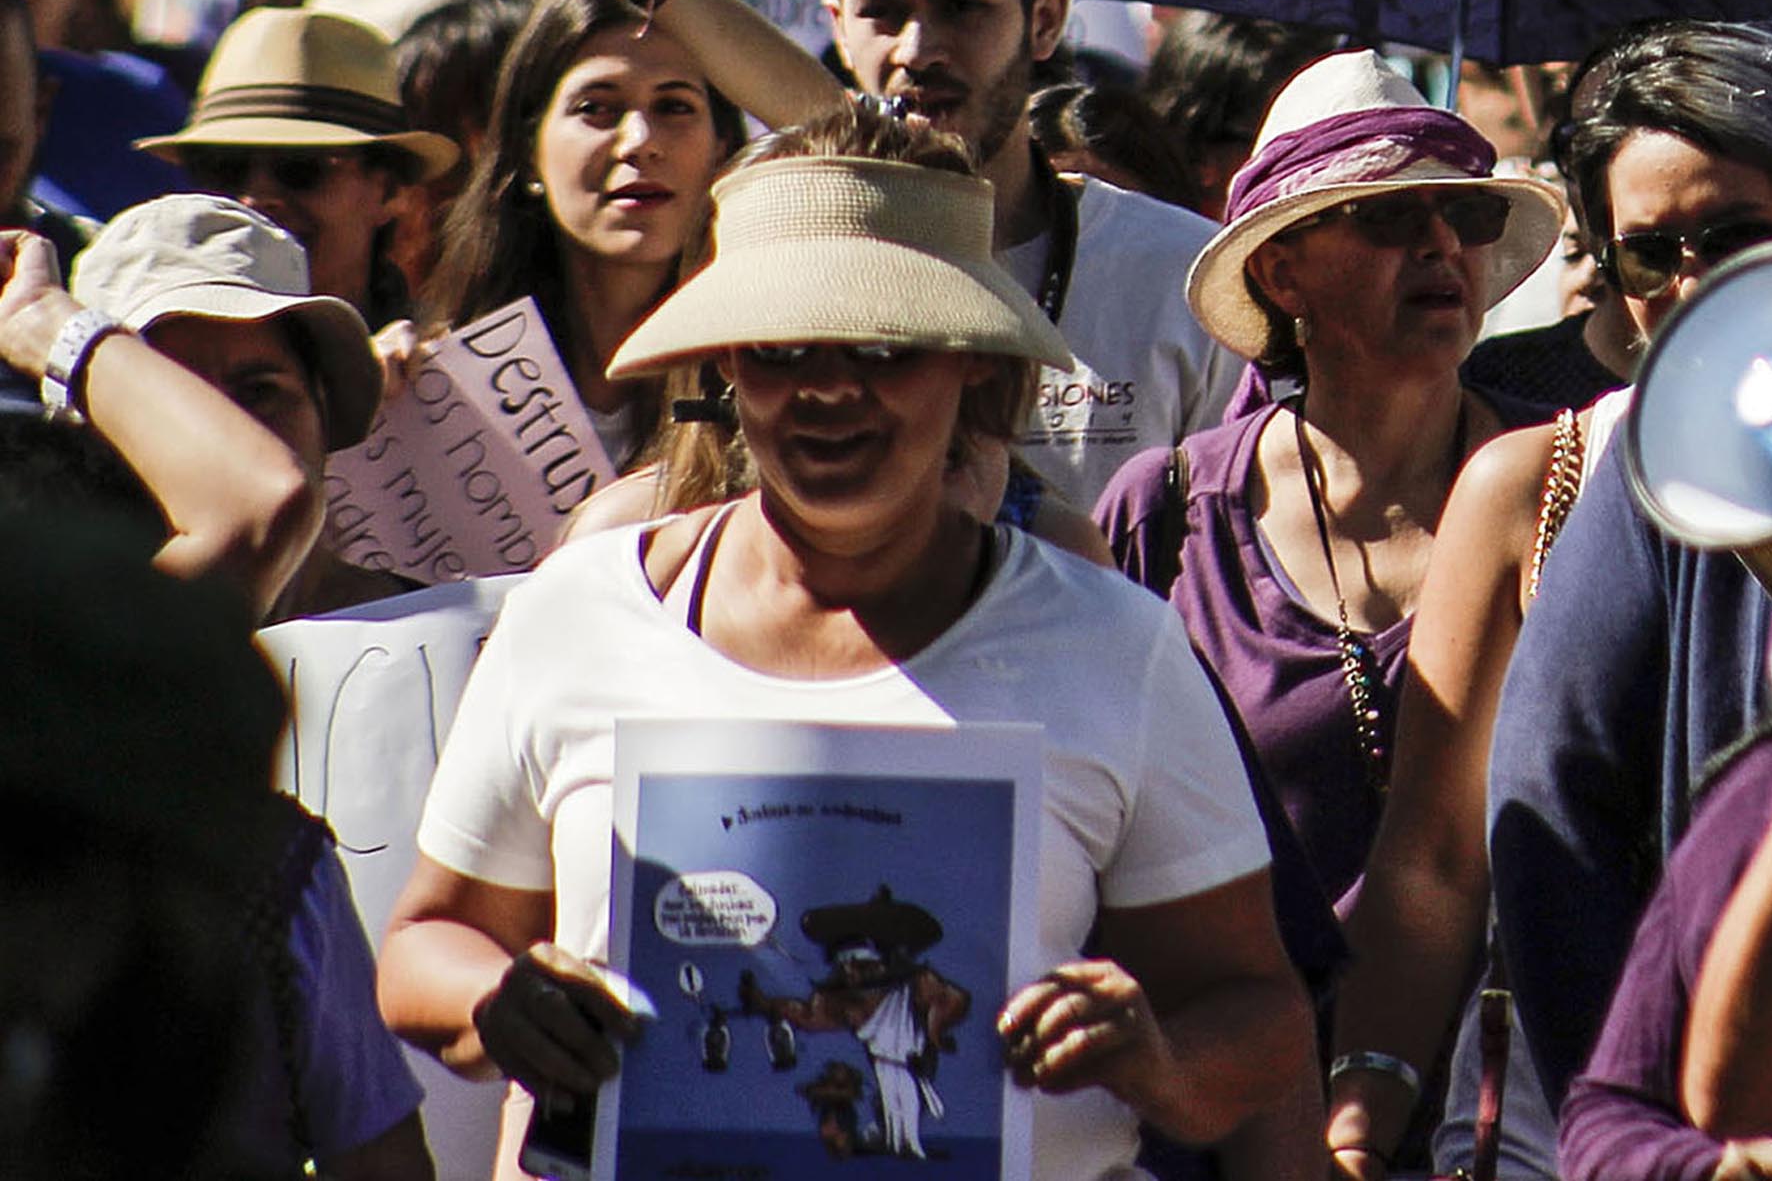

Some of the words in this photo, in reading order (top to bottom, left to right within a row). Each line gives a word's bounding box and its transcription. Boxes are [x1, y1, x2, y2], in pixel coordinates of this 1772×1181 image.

[1039, 381, 1135, 407] SIONES
[382, 467, 467, 582] muje
[445, 429, 537, 567] homb
